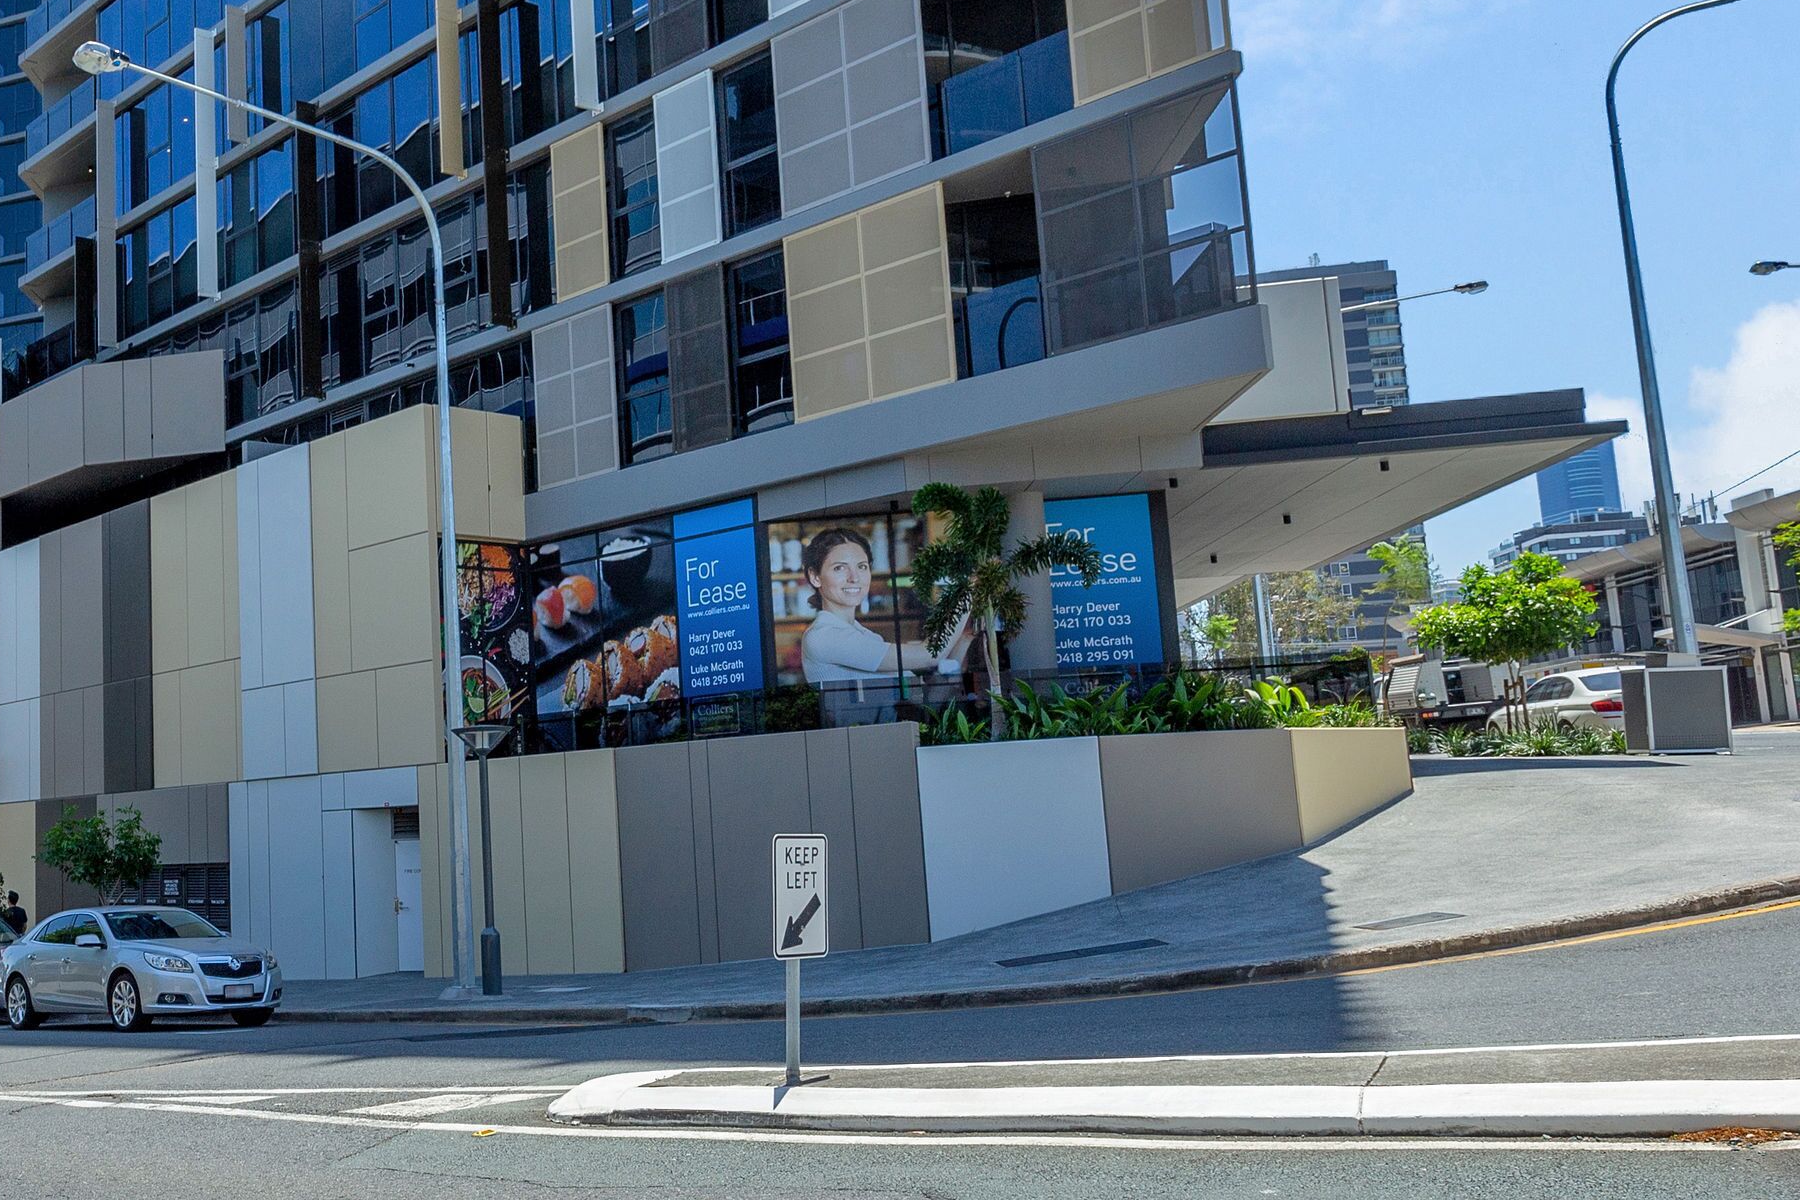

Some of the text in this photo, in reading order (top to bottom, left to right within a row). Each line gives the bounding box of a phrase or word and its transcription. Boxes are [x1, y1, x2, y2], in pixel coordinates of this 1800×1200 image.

[685, 557, 719, 582] For
[1048, 552, 1137, 576] Lese
[686, 581, 747, 607] Lease
[687, 603, 750, 619] www.colliers.com.au
[1086, 602, 1120, 613] Dever
[1083, 616, 1104, 628] 170
[1107, 614, 1132, 626] 033
[688, 628, 736, 644] Harry Dever
[1083, 634, 1133, 648] McGrath
[689, 640, 743, 657] 0421 170 033
[1087, 650, 1110, 662] 295
[1113, 649, 1134, 661] 091
[690, 659, 744, 675] Luke McGrath
[691, 672, 745, 688] 0418 295 091
[785, 847, 819, 865] KEEP
[786, 871, 817, 889] LEFT
